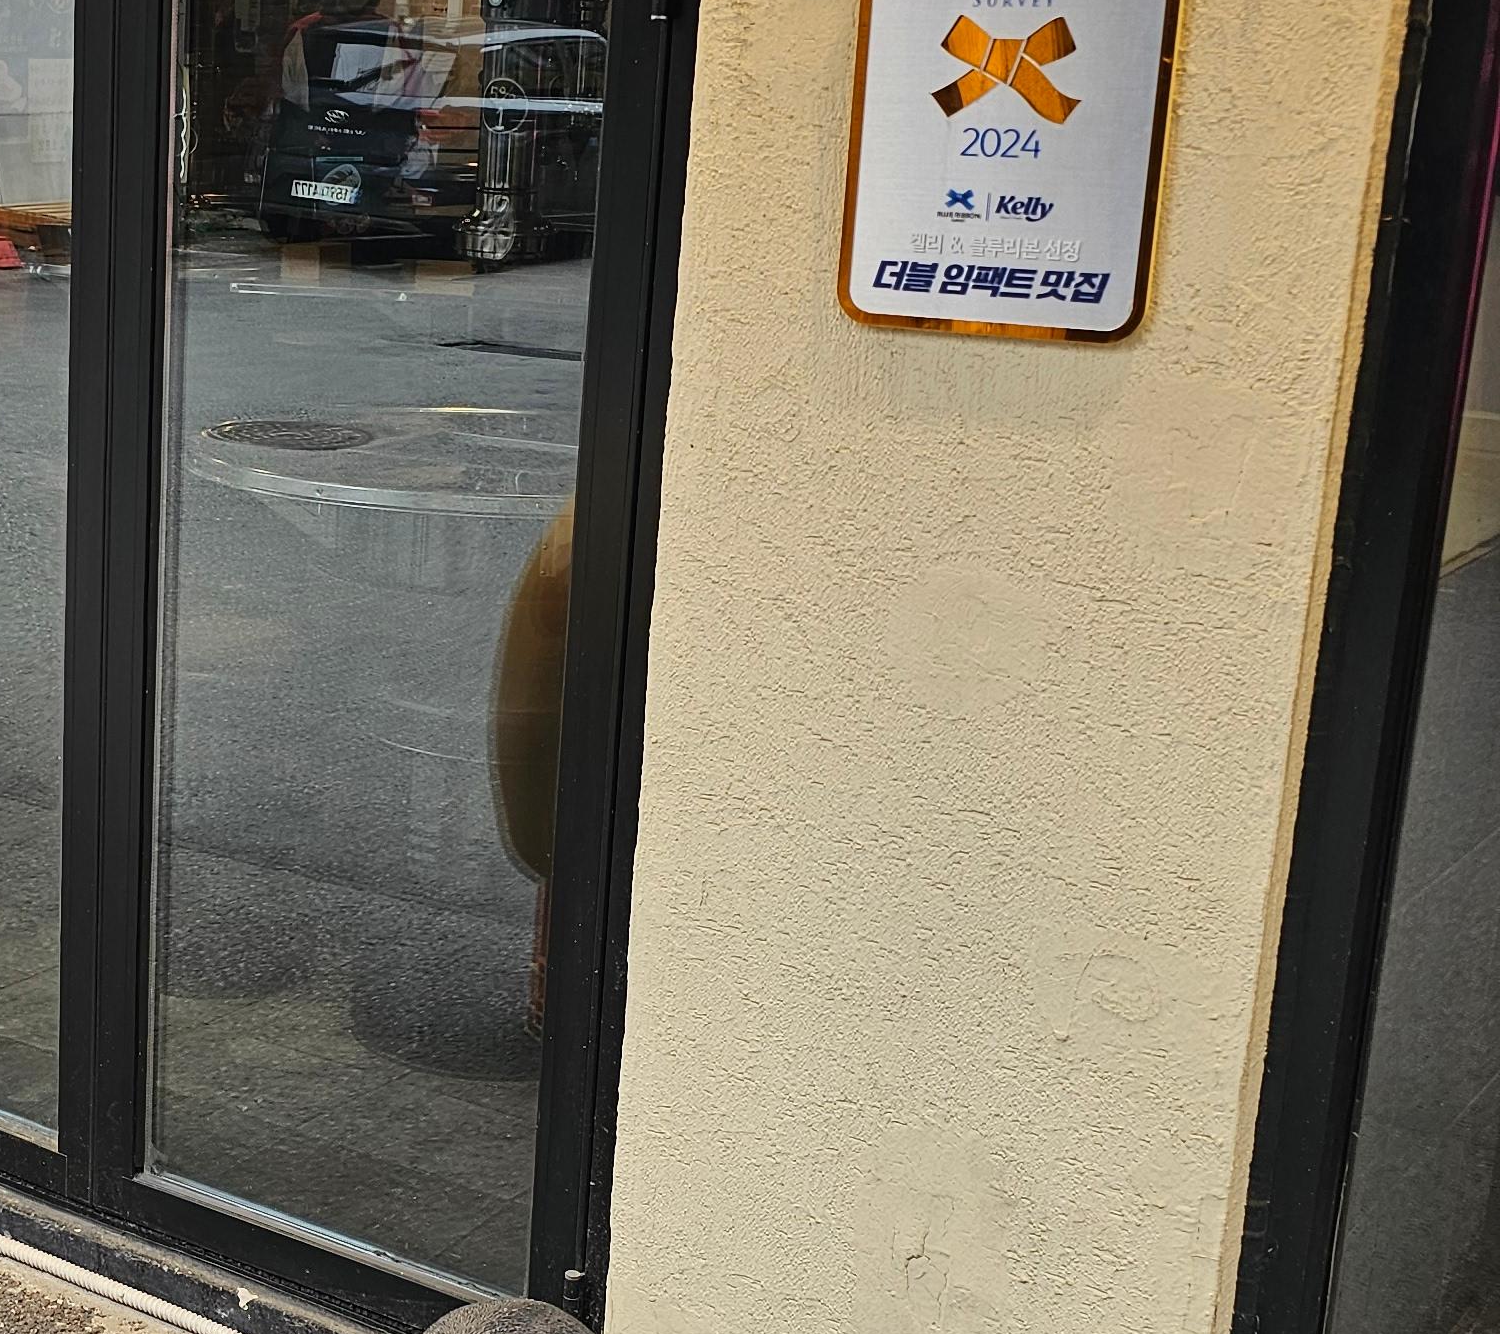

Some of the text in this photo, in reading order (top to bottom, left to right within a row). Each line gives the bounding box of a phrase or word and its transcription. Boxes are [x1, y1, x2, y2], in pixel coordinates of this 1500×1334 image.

[960, 128, 1041, 158] 2024
[995, 195, 1054, 222] Kelly
[970, 237, 1040, 259] 블루리본
[1044, 239, 1082, 262] 선정
[872, 260, 1111, 304] 더블 임팩트 맛집
